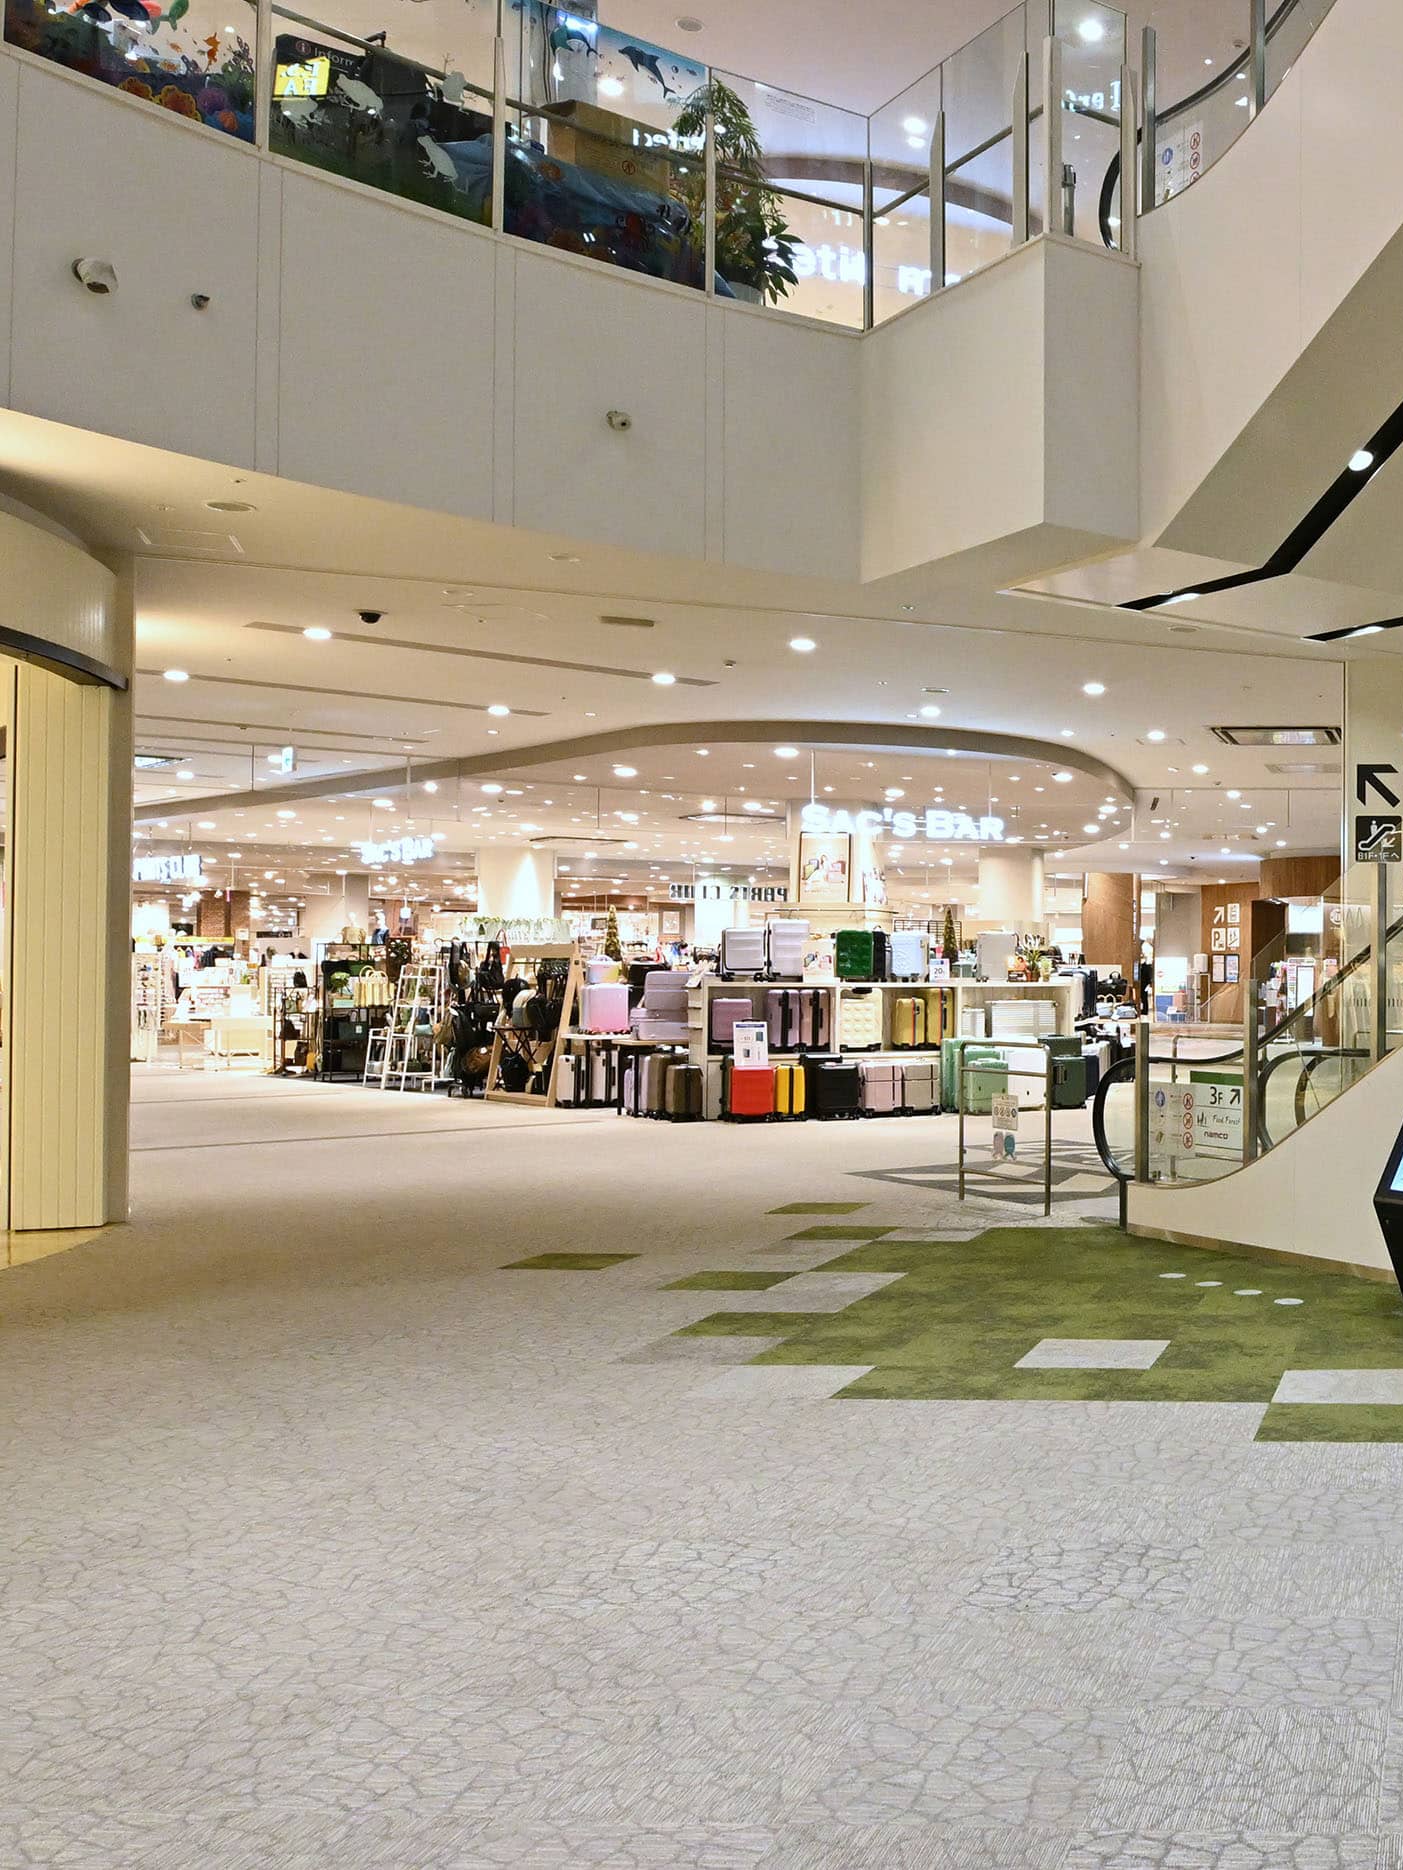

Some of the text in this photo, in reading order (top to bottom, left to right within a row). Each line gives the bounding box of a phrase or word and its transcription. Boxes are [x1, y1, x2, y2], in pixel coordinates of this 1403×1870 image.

[926, 809, 1005, 840] BAR
[1210, 1086, 1223, 1104] 3F
[1204, 1131, 1228, 1140] namco
